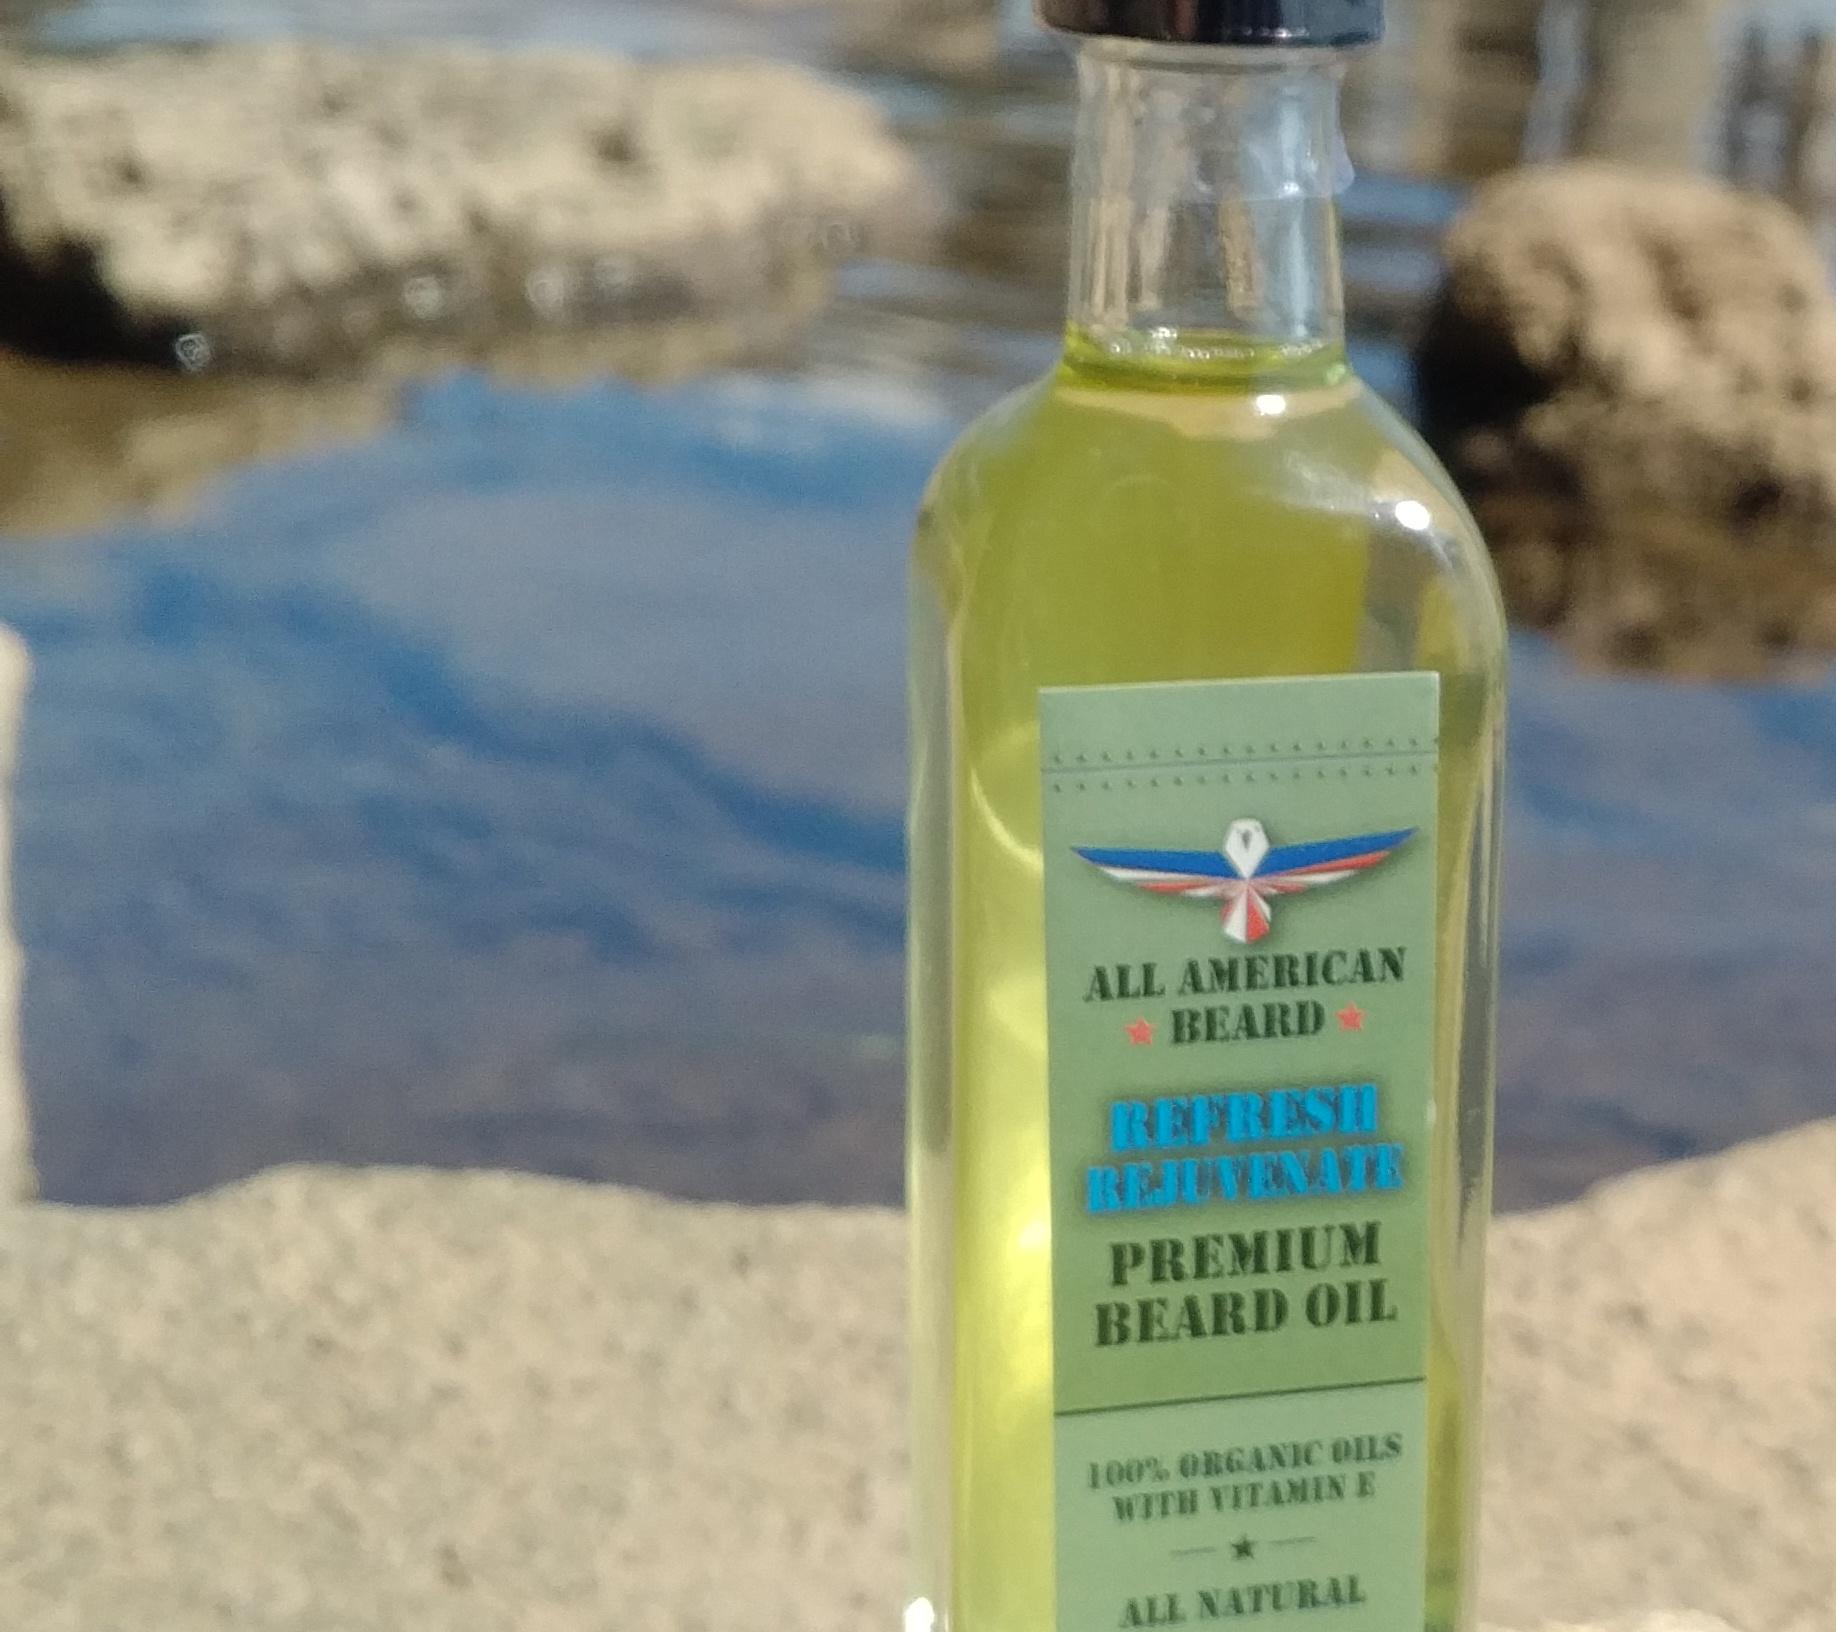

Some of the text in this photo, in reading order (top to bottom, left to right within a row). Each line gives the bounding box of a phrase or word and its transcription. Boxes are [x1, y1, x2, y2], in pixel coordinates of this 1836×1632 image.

[1083, 947, 1407, 1002] ALL AMERICAN
[1170, 1000, 1325, 1044] BEARD
[1110, 1083, 1378, 1153] REFRESH
[1086, 1142, 1404, 1213] REJUVENATE
[1109, 1220, 1382, 1287] PREMIUM
[1095, 1278, 1398, 1347] BEARD OIL
[1087, 1432, 1403, 1489] 100% ORGANIC OILS
[1112, 1471, 1376, 1521] WITH VITAMIN E
[1118, 1574, 1367, 1628] ALL NATURAL
